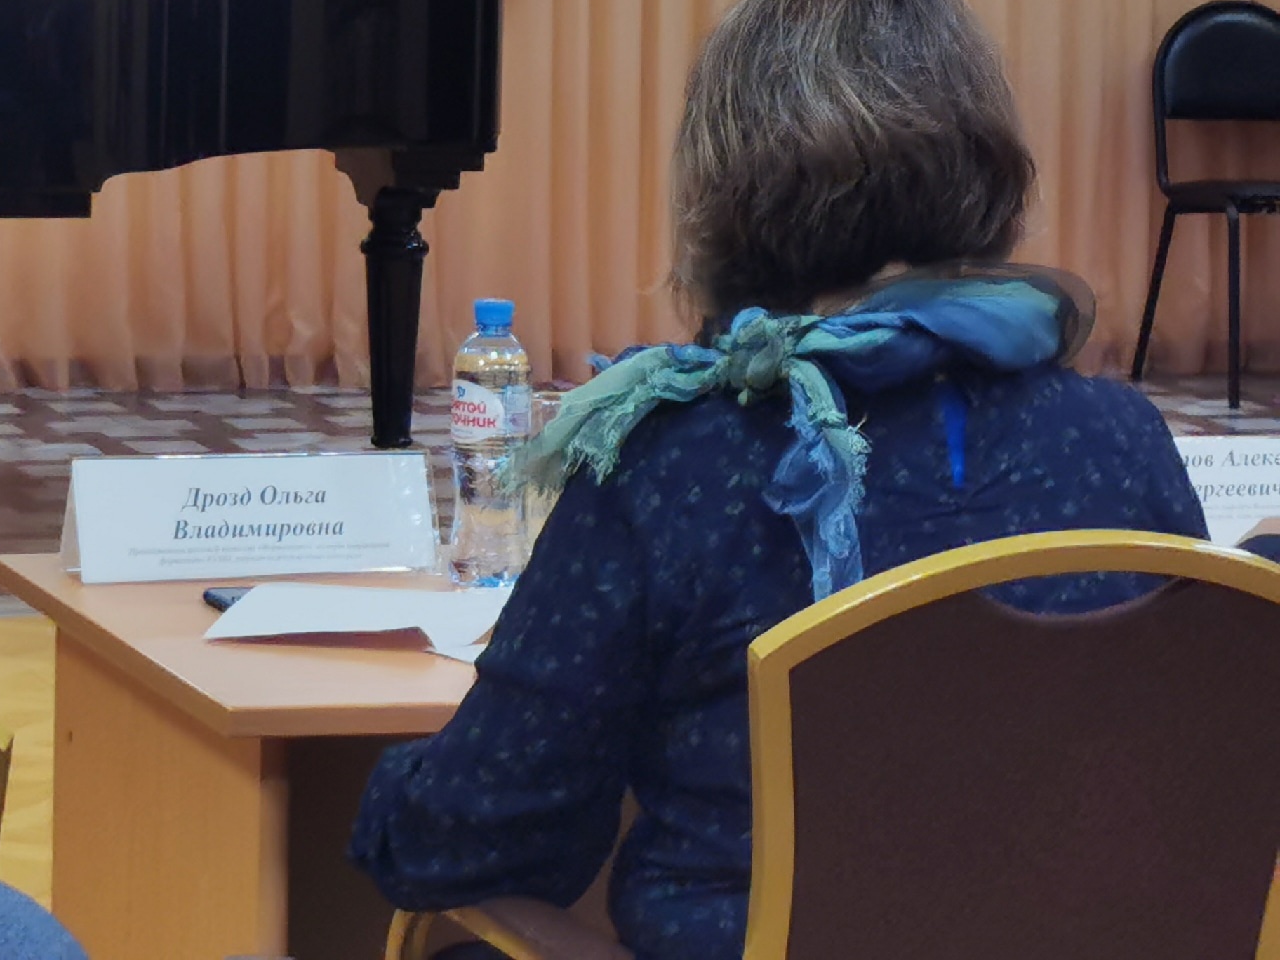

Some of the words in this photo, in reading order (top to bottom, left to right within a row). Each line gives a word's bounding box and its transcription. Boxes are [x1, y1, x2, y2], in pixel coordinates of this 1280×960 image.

[452, 399, 486, 414] ЯТОЙ
[452, 413, 496, 428] ОЧНИК
[181, 486, 252, 512] Дрозд
[260, 485, 326, 506] Ольга
[174, 519, 344, 542] Владимировна
